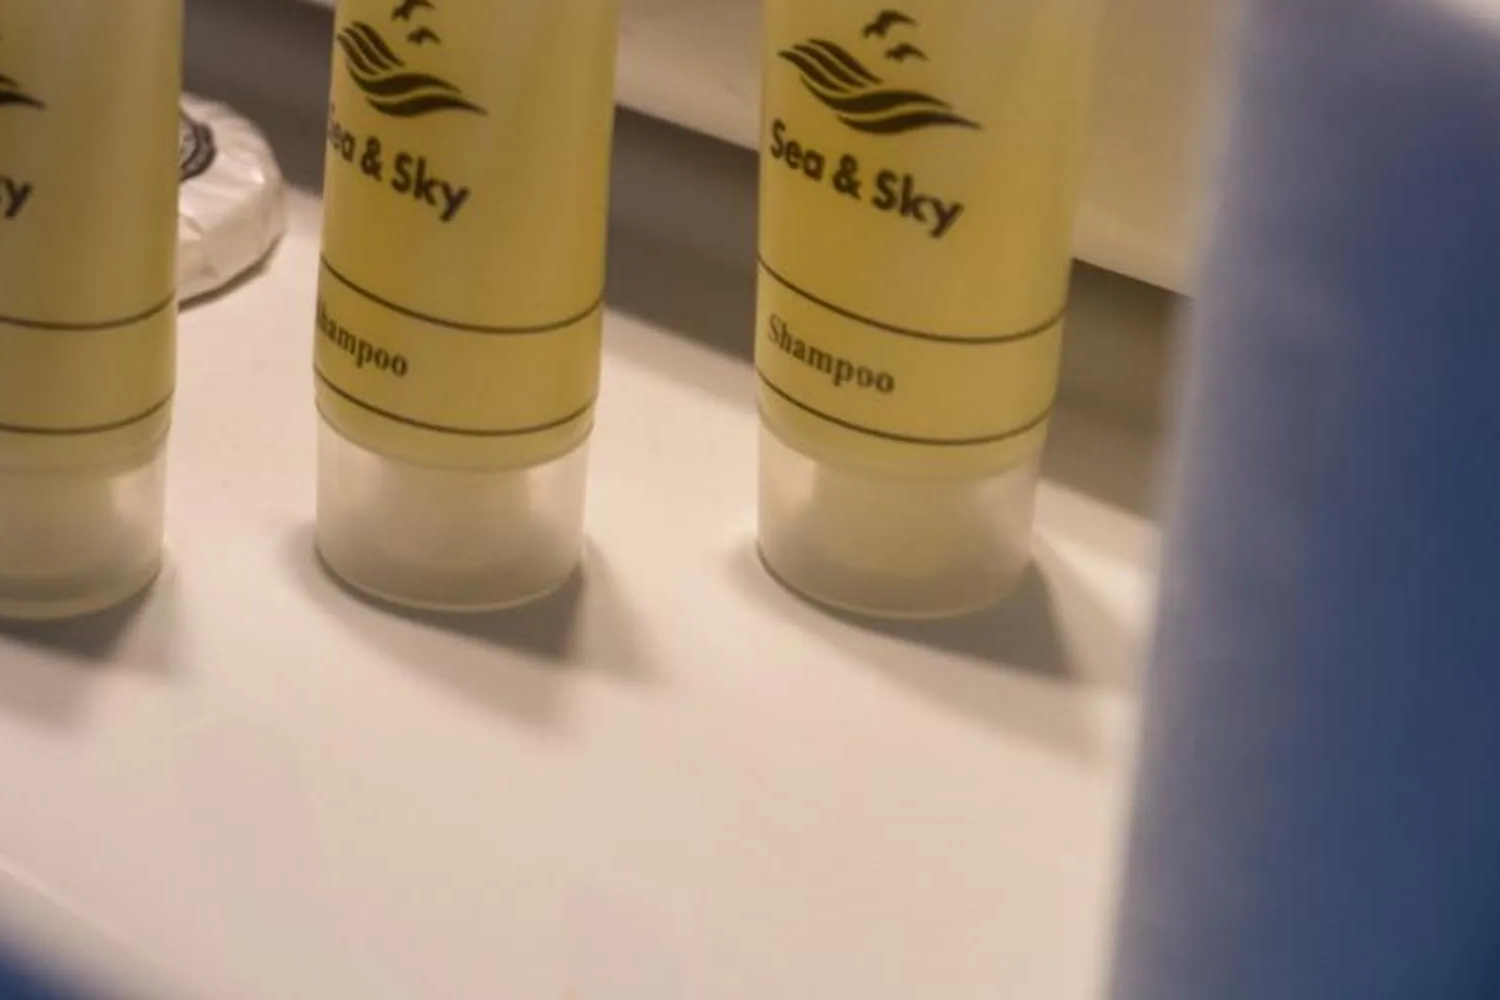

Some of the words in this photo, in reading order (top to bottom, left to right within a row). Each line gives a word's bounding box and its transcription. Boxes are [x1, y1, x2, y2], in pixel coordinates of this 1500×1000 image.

[360, 135, 383, 183] &
[390, 151, 470, 223] Sky
[768, 118, 825, 183] Sea
[831, 154, 863, 197] &
[870, 169, 966, 239] Sky
[766, 312, 896, 395] Shampoo
